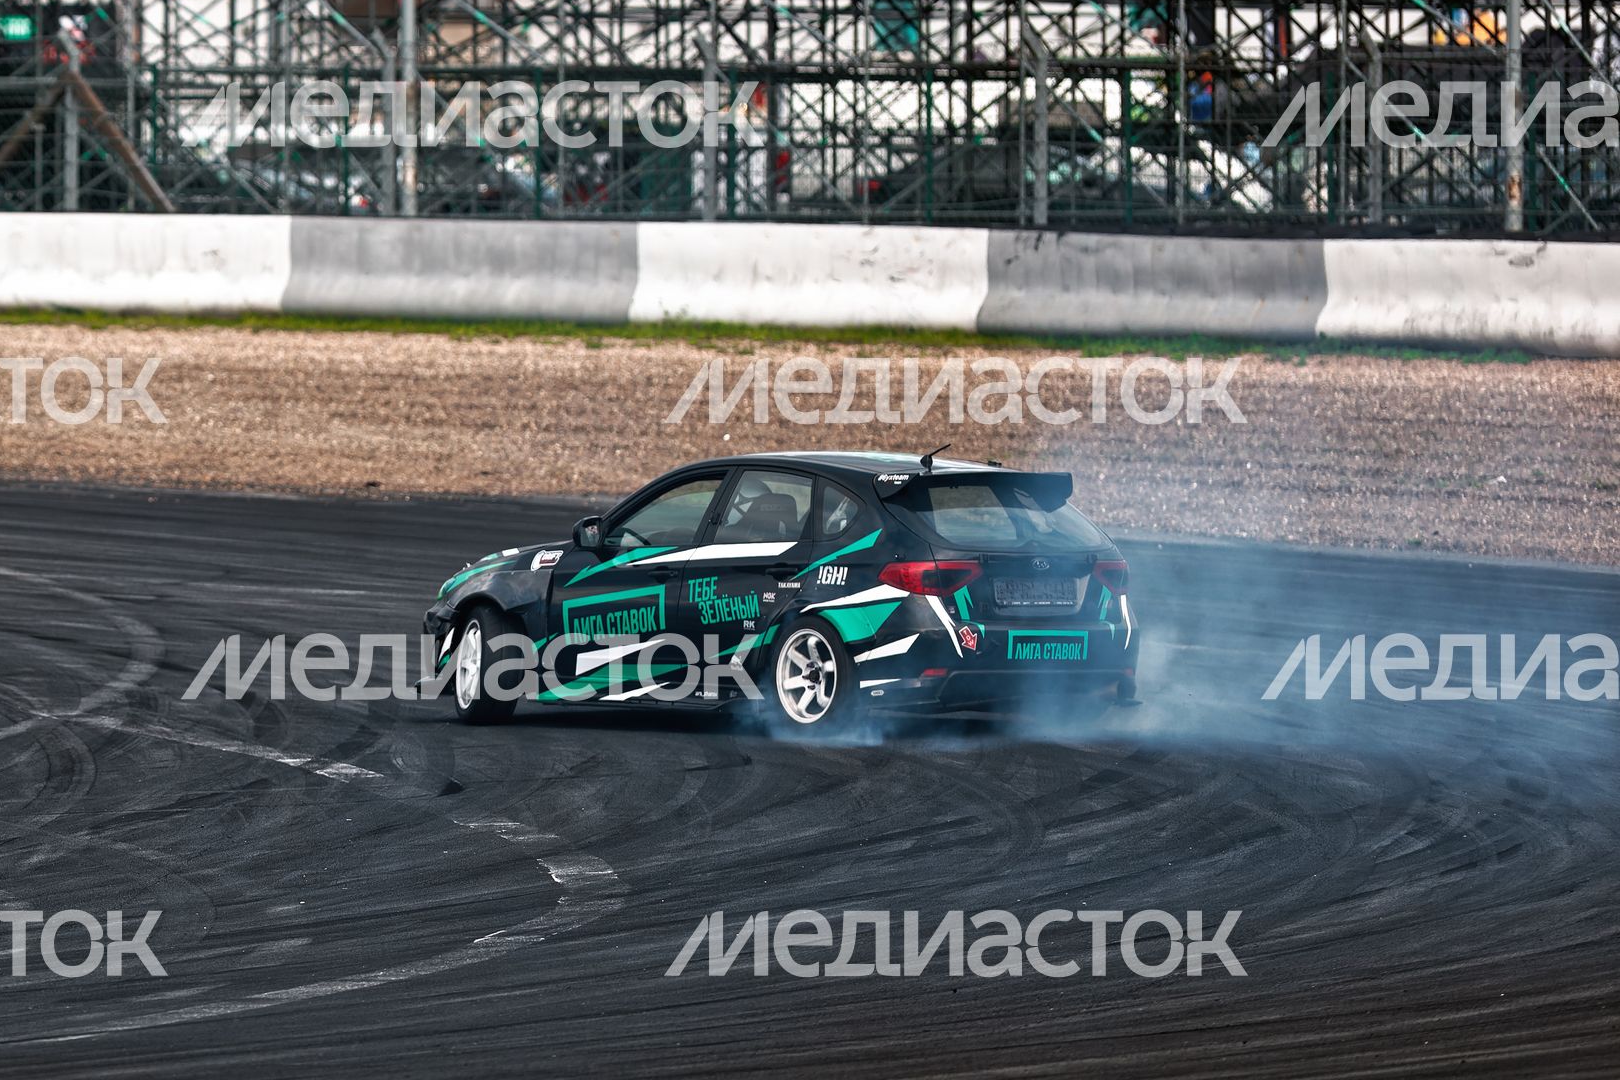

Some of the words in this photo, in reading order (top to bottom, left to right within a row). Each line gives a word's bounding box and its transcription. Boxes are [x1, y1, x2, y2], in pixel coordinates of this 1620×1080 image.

[688, 576, 718, 603] ТЕБЕ
[698, 590, 761, 625] ЗЕЛЁНЫЙ
[573, 614, 605, 644] ЛИГА
[606, 605, 657, 638] СТАВОК
[962, 629, 975, 647] TOW
[1015, 642, 1041, 660] ЛИГА
[1043, 642, 1081, 660] СТАВОК
